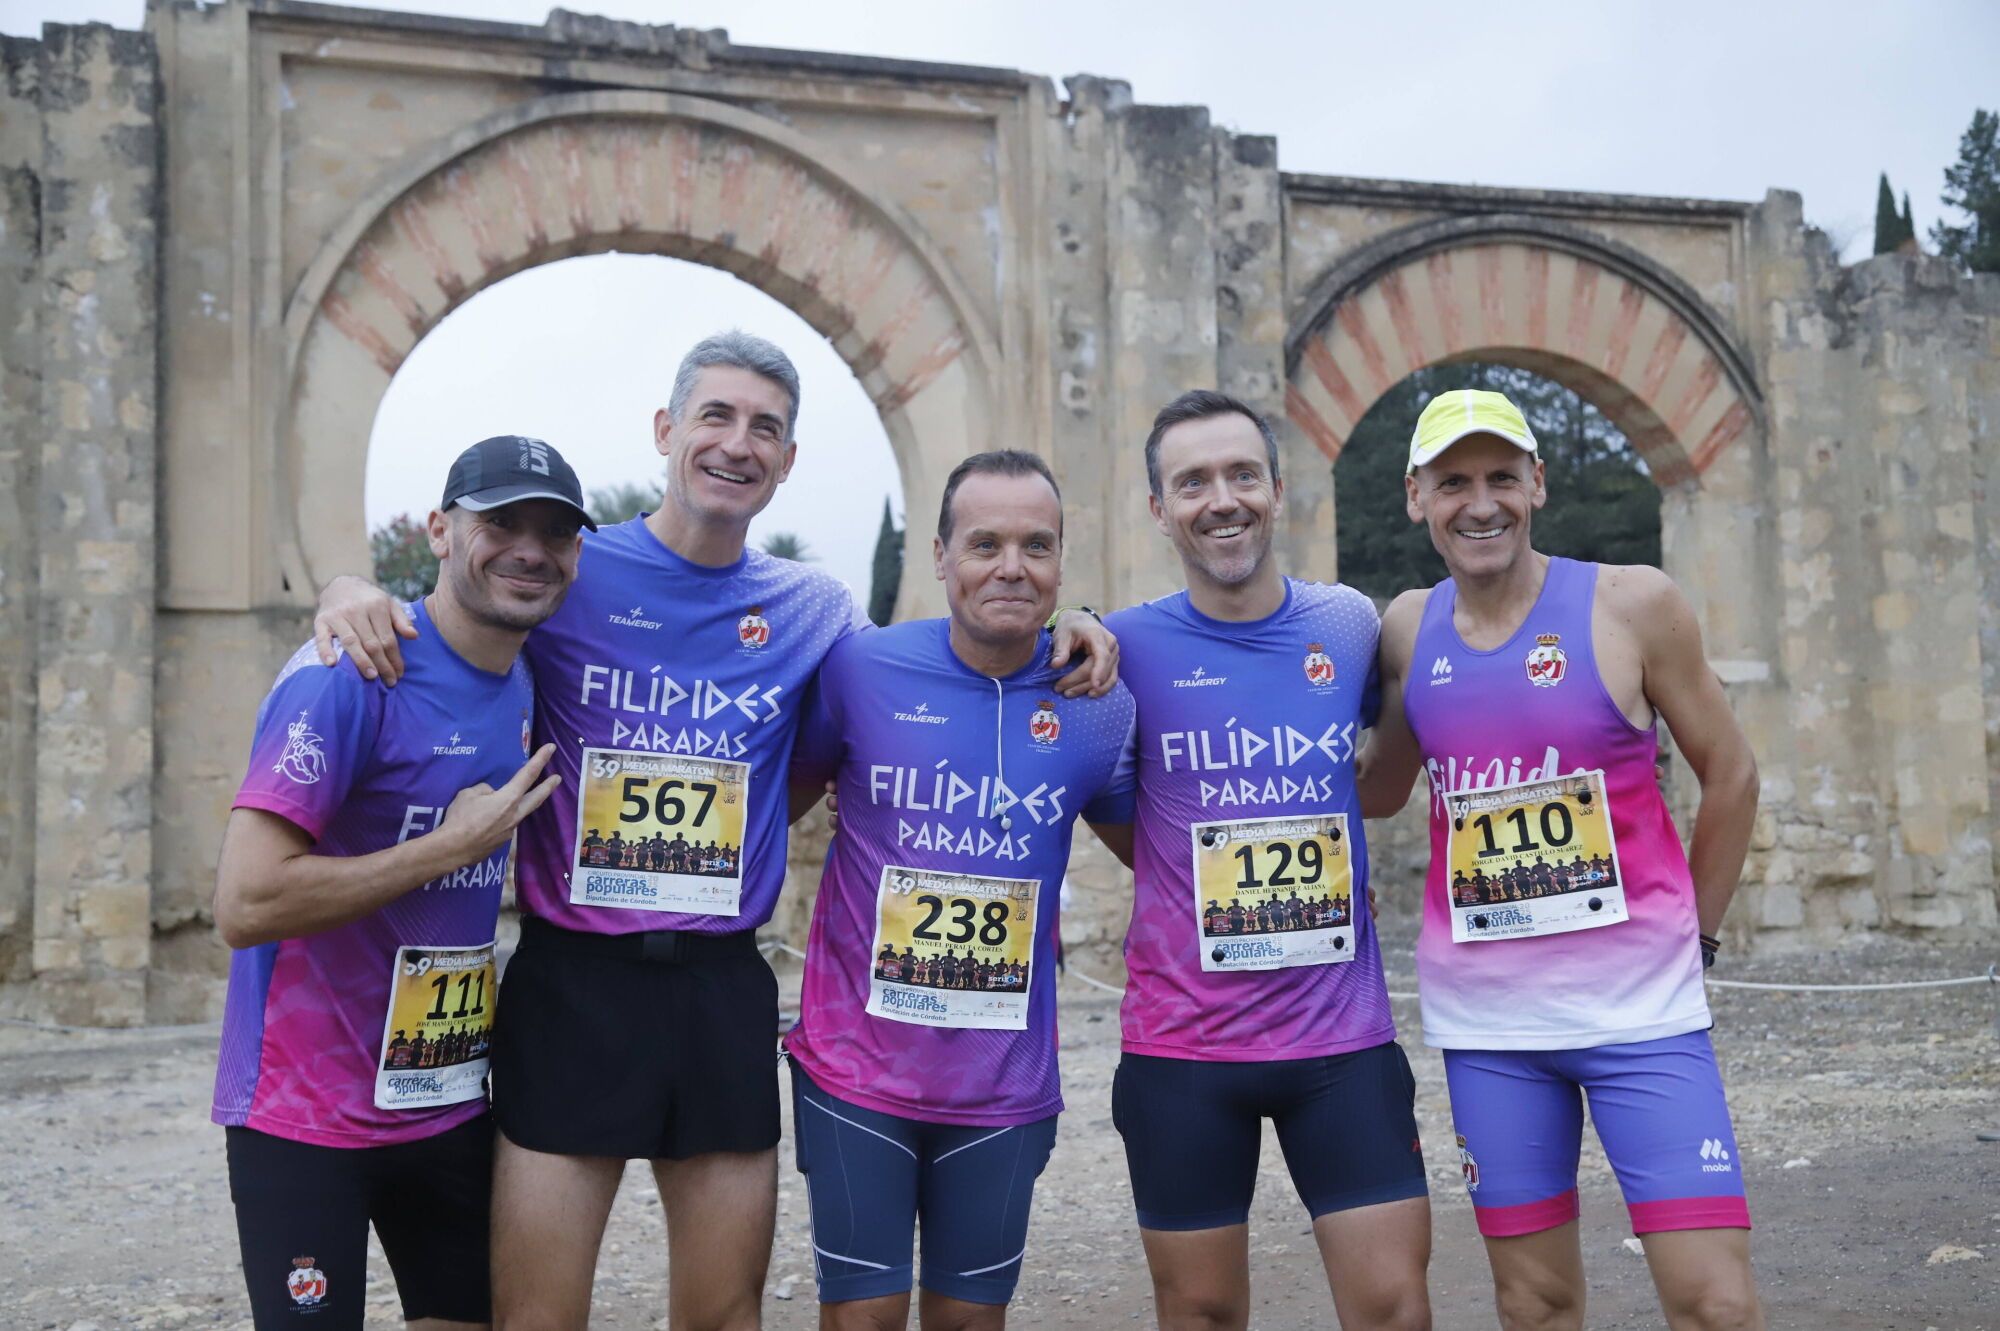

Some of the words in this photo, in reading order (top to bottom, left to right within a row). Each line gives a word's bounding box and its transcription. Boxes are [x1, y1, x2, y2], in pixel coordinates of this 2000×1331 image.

[608, 615, 663, 631] TEAMERGY
[1173, 677, 1227, 688] TEAMERGY
[1431, 675, 1452, 687] mobel
[581, 664, 782, 724] FILÍPIDES
[894, 712, 949, 725] TEAMERGY
[612, 718, 749, 758] PARADAS
[1161, 716, 1355, 772] FILÍPIDES
[433, 746, 478, 755] TEAMERGY
[592, 759, 620, 779] 39
[622, 760, 658, 773] MEDIA
[870, 758, 1066, 827] FILÍPIDES
[1199, 774, 1333, 807] PARADAS
[620, 778, 717, 827] 567
[1452, 799, 1470, 820] 39
[1470, 796, 1503, 810] MEDIA
[1230, 828, 1264, 840] MEDIA
[1474, 802, 1573, 858] 110
[898, 818, 1031, 862] PARADAS
[1235, 840, 1323, 888] 129
[1471, 858, 1494, 867] JORGE
[1496, 854, 1518, 863] DAVID
[1519, 849, 1555, 859] CASTILLO
[587, 875, 647, 888] carreras
[889, 875, 916, 895] 39
[918, 879, 953, 891] MEDIA
[586, 883, 658, 896] populares
[1235, 888, 1260, 896] DANIEL
[586, 894, 618, 903] Diputación
[629, 897, 657, 905] Córdoba
[912, 895, 1009, 946] 238
[1465, 908, 1520, 922] carreras
[1510, 927, 1535, 935] Córdoba
[914, 939, 942, 949] MANUEL
[945, 942, 976, 951] PERALTA
[1215, 940, 1272, 951] carreras
[1222, 947, 1284, 961] opulares
[434, 958, 461, 967] MEDIA
[427, 970, 486, 1020] 111
[882, 988, 938, 1005] carreras
[881, 995, 947, 1013] populares
[881, 1006, 910, 1017] Diputación
[920, 1013, 946, 1021] Córdoba
[388, 1076, 436, 1087] carreras
[394, 1083, 443, 1096] opulares
[1702, 1162, 1732, 1173] mobel
